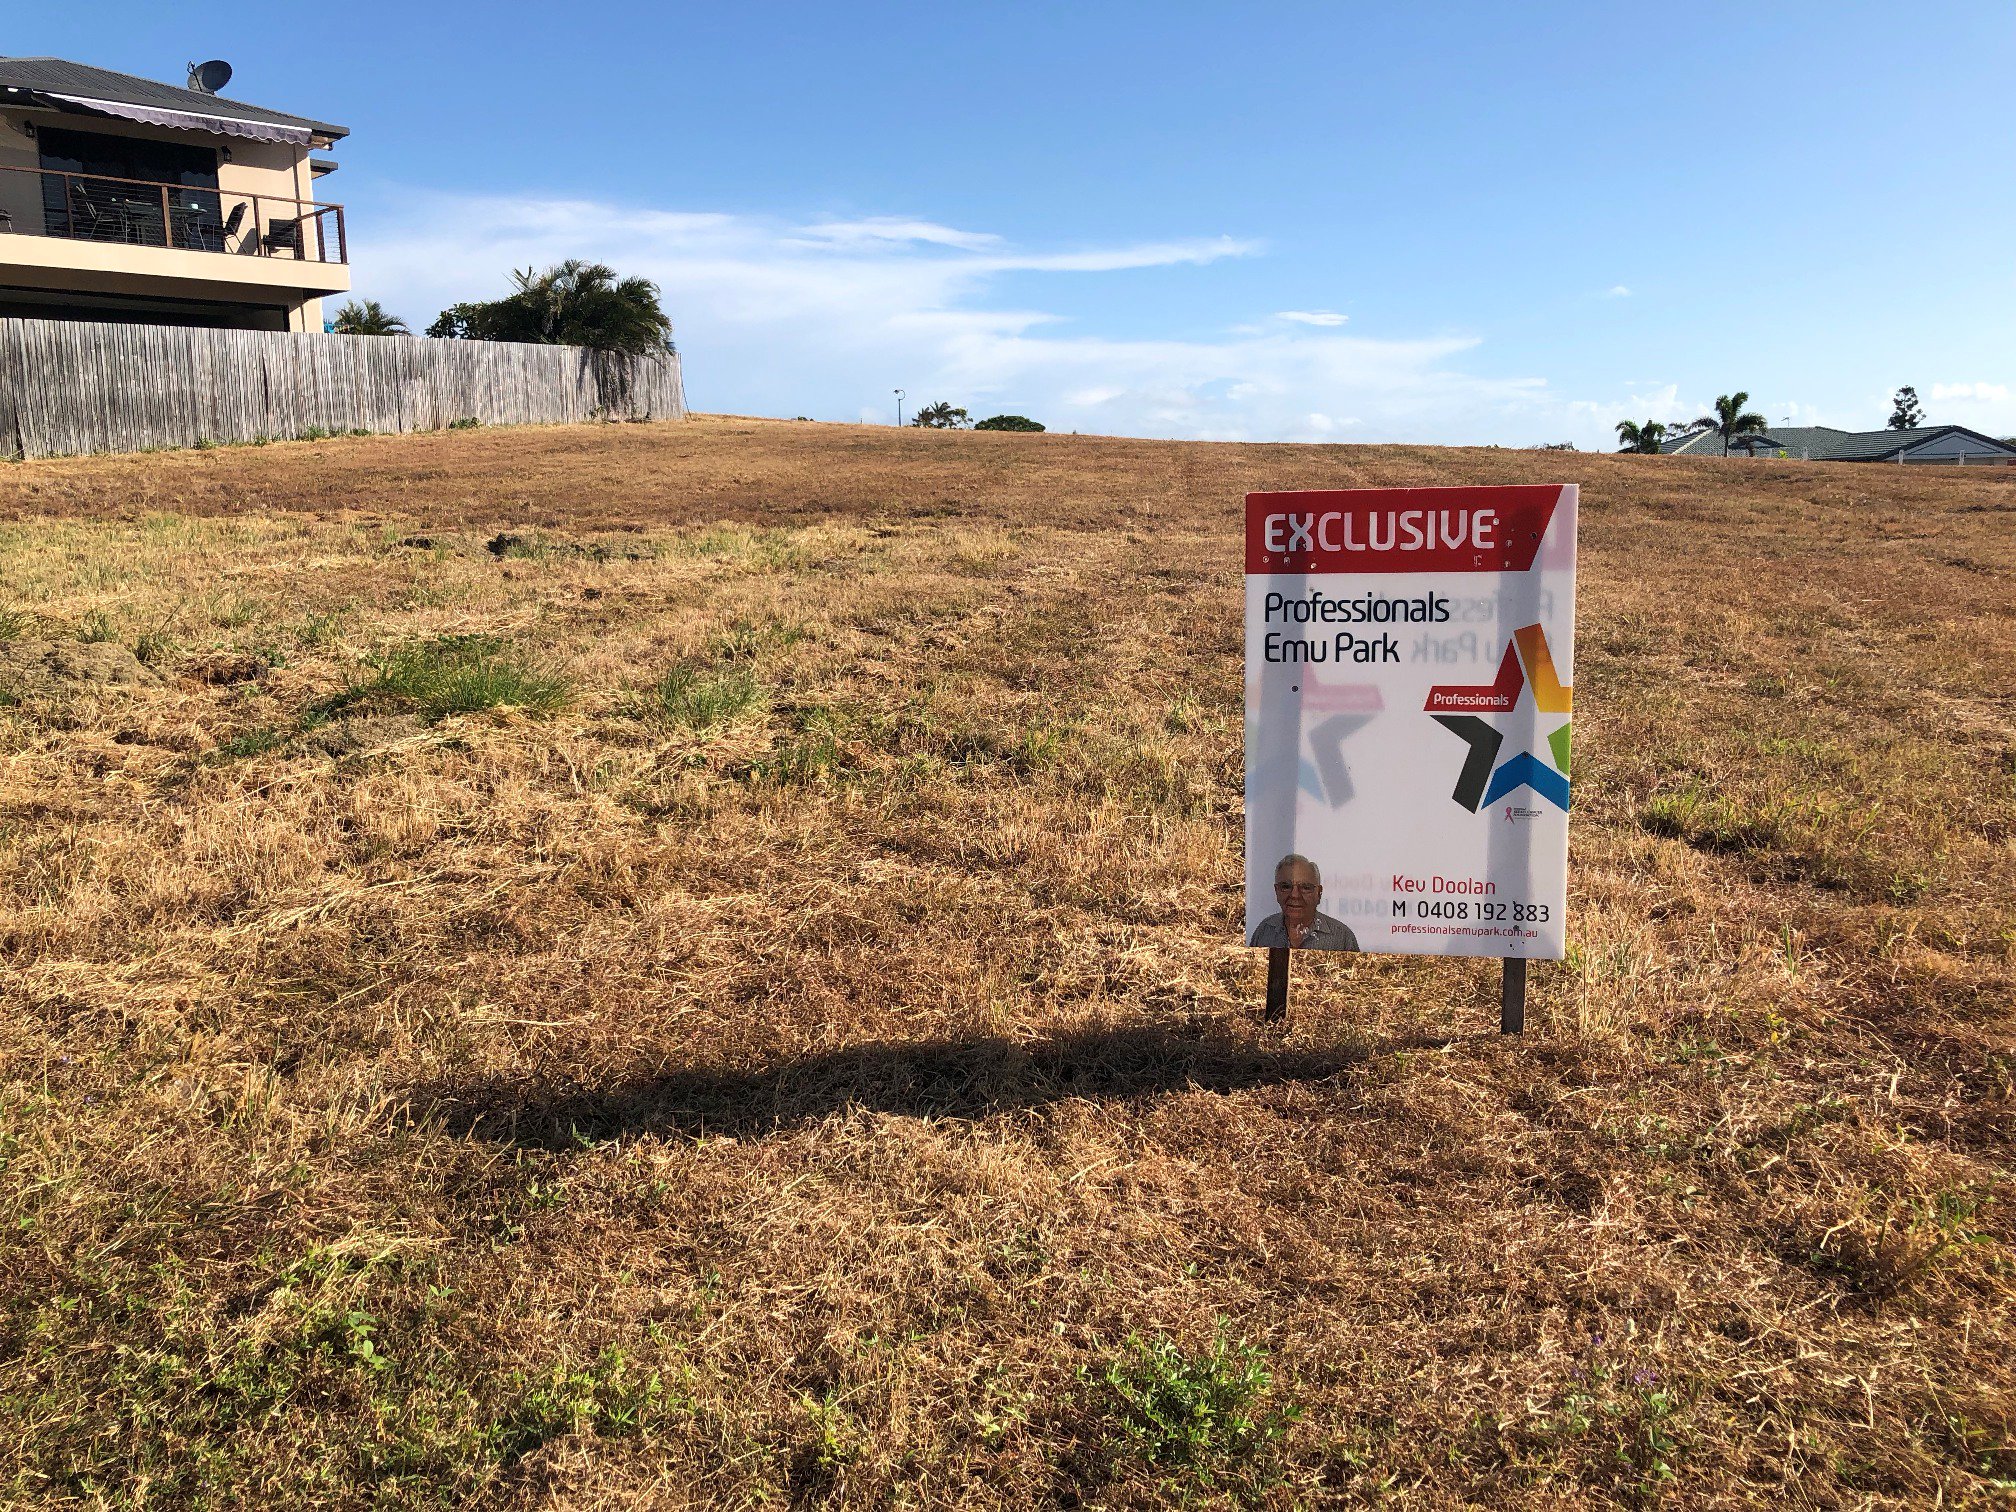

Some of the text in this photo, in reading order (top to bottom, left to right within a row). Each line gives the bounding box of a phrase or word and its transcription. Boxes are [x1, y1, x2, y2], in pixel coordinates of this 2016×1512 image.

[1264, 509, 1496, 552] EXCLUSIVE
[1264, 591, 1450, 623] Professionals
[1264, 632, 1401, 663] Emu Park
[1433, 693, 1509, 706] Professionals
[1392, 875, 1496, 895] Kev Doolan
[1392, 900, 1550, 923] M 0408 192 883
[1391, 923, 1538, 938] professionalsemupark.com.au
